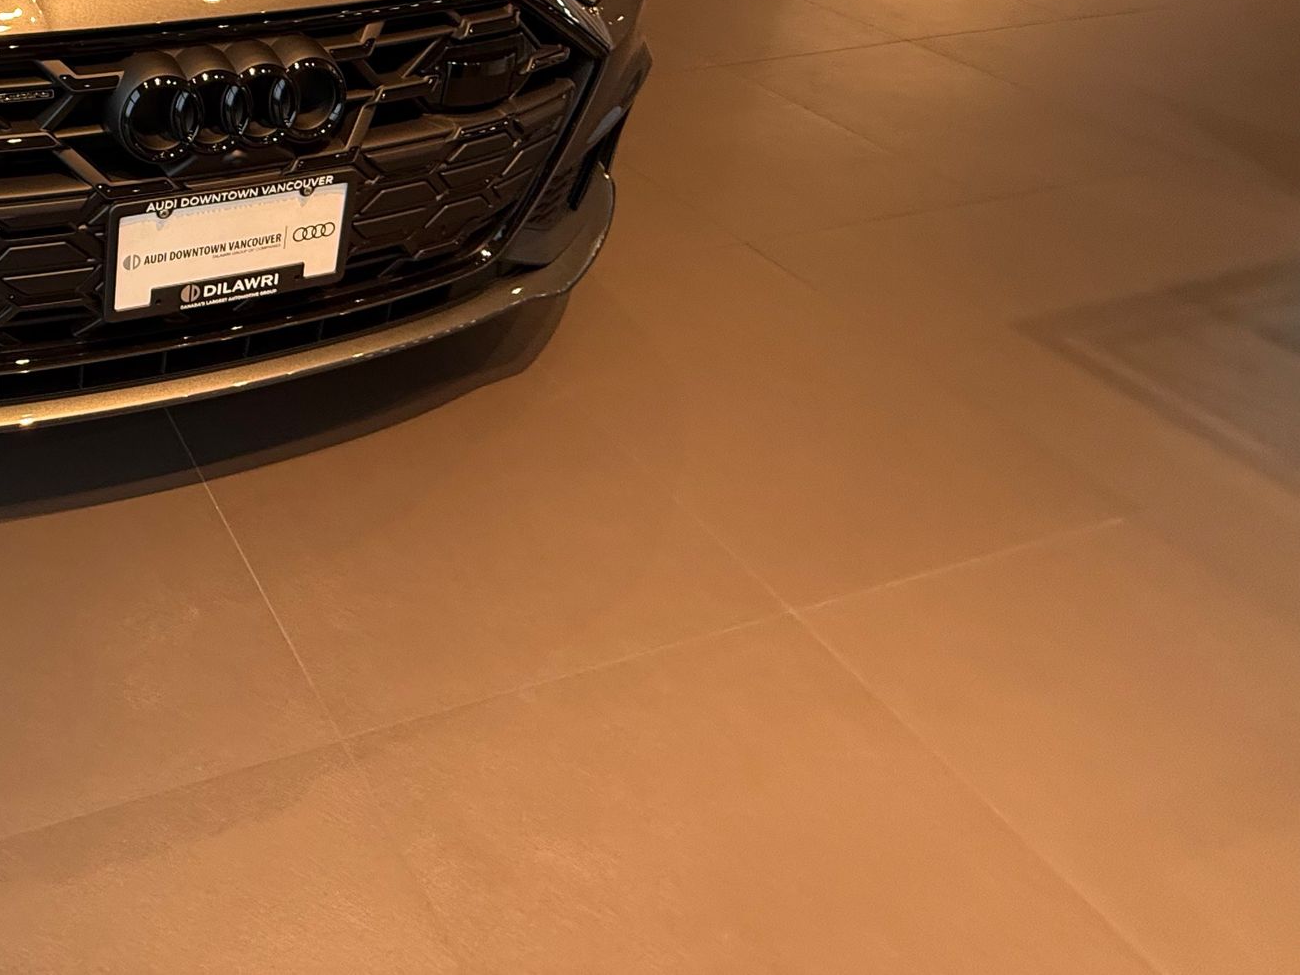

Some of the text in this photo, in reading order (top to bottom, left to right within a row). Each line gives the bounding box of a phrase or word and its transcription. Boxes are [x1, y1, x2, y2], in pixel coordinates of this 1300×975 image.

[146, 175, 334, 213] AUDI DOWNTOWN VANCOUVER
[144, 233, 282, 265] AUDI DOWNTOWN VANCOUVER
[203, 273, 279, 297] DILAWRI
[206, 297, 228, 306] LARGEST
[228, 292, 259, 302] AUTOMOTIVE
[259, 288, 278, 296] GROUP
